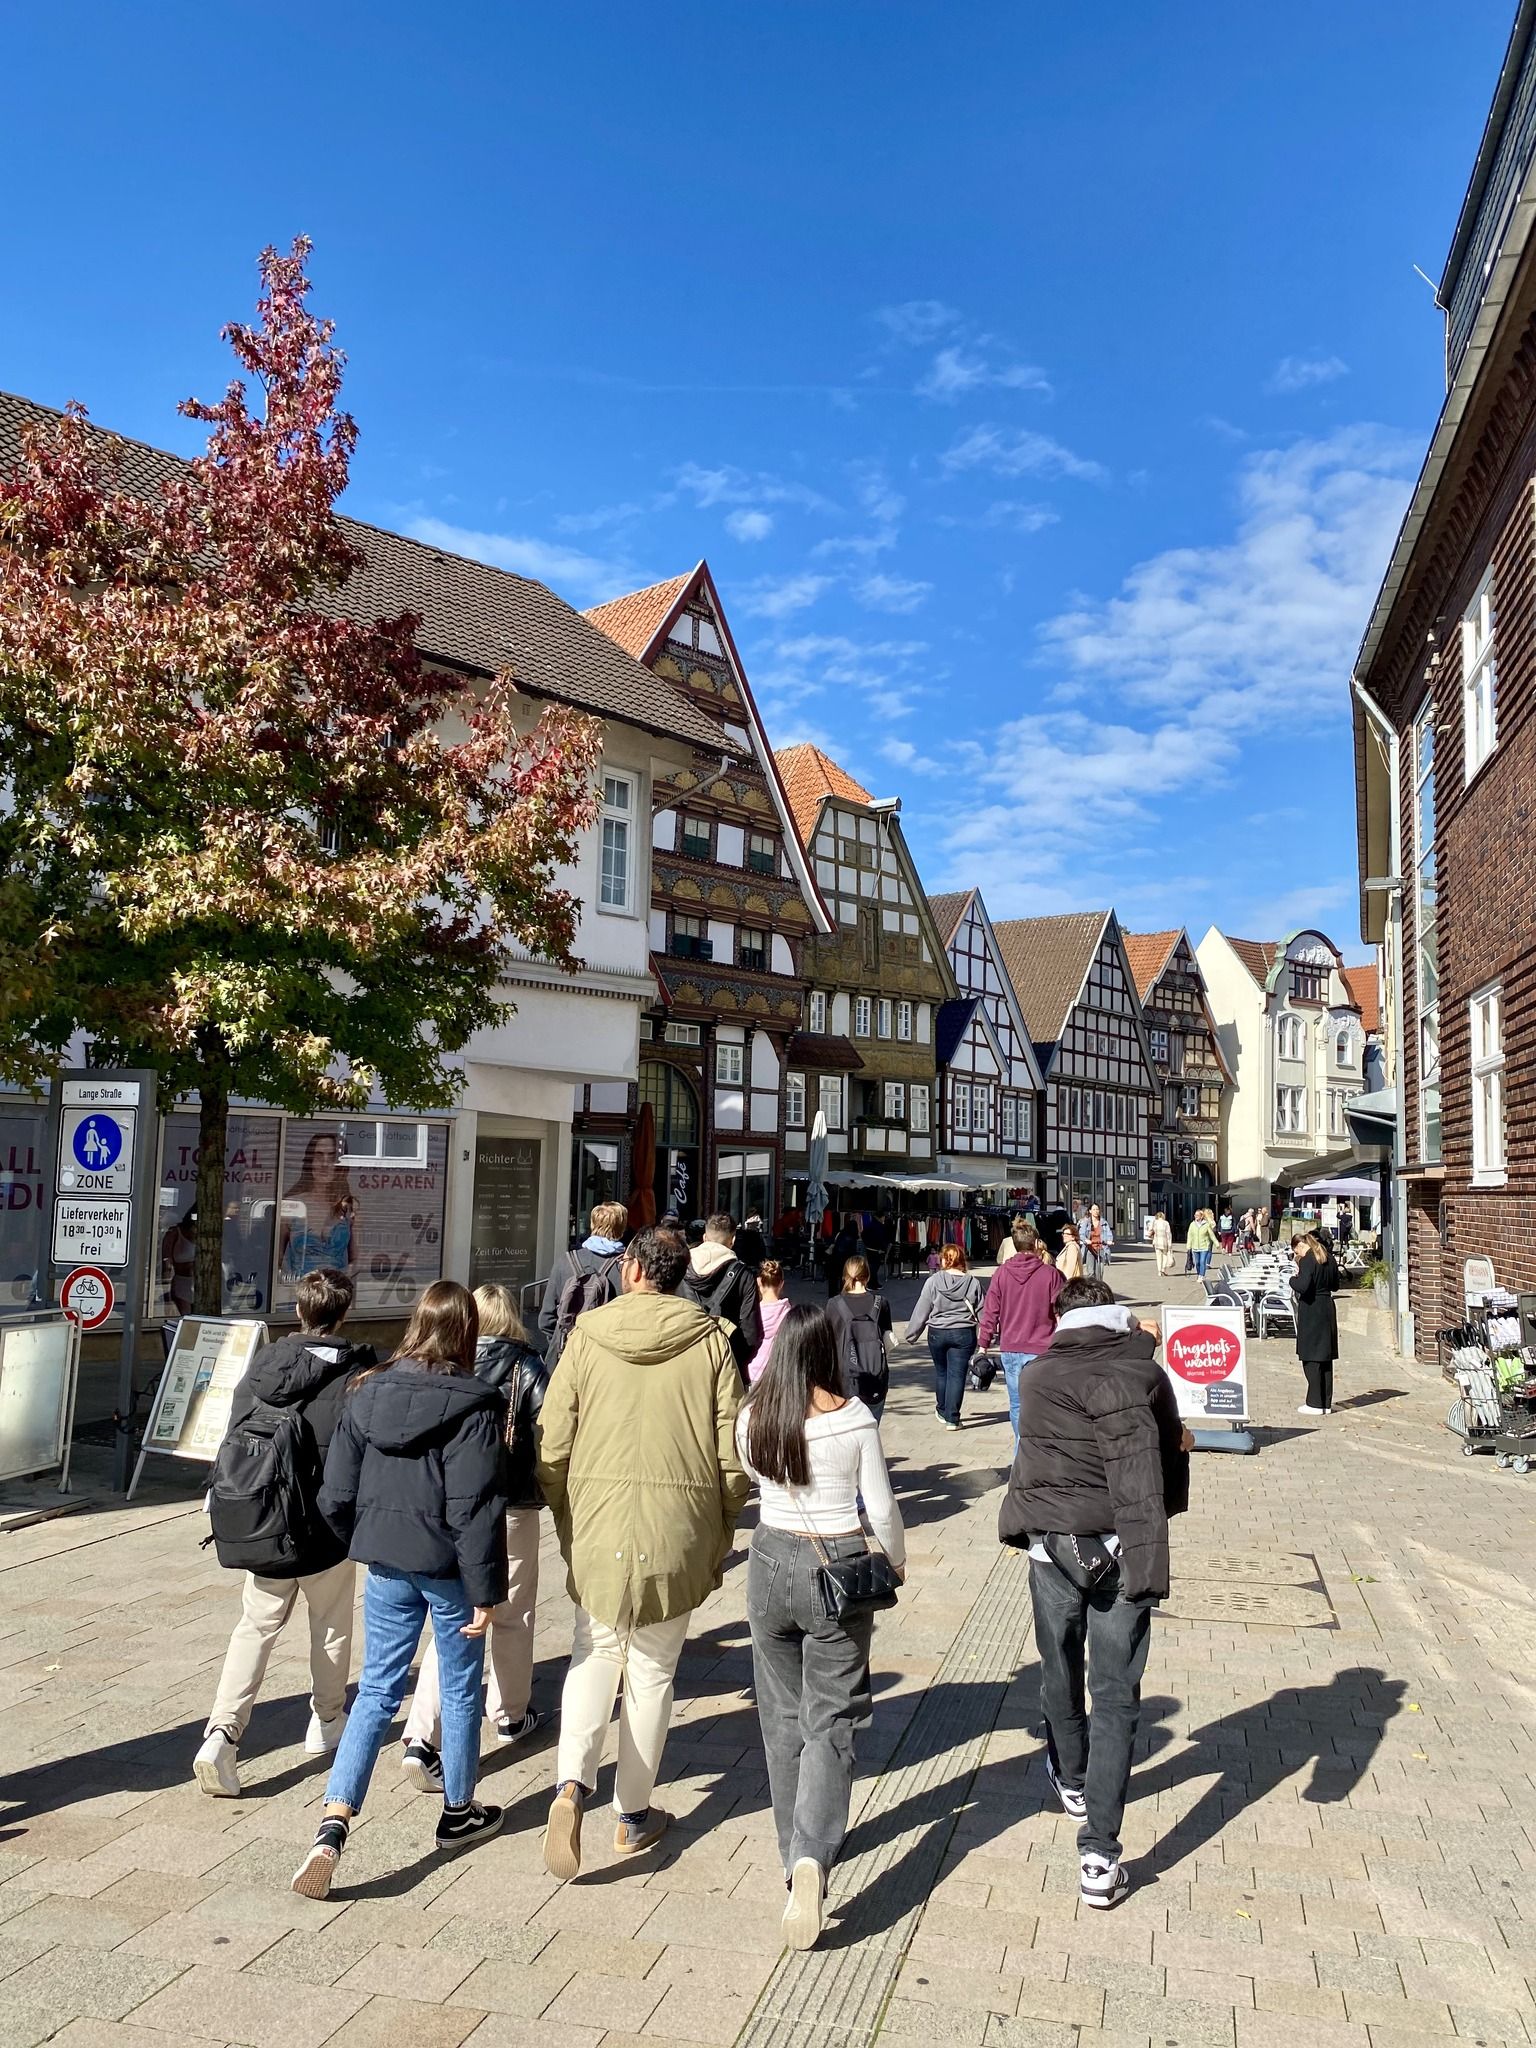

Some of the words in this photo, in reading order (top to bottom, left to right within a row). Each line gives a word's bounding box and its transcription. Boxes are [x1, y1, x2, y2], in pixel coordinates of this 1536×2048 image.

[79, 1089, 98, 1100] Lange
[100, 1088, 122, 1099] Straße
[480, 1153, 515, 1164] Richter
[76, 1175, 114, 1189] ZONE
[674, 1161, 690, 1204] Café
[61, 1206, 124, 1221] Lieferverkehr
[116, 1226, 122, 1239] h
[80, 1242, 102, 1256] frei
[475, 1247, 490, 1256] Zeit
[492, 1247, 503, 1256] für
[504, 1247, 528, 1256] Neues
[1172, 1338, 1236, 1359] Angebots-
[1184, 1354, 1227, 1368] woche!
